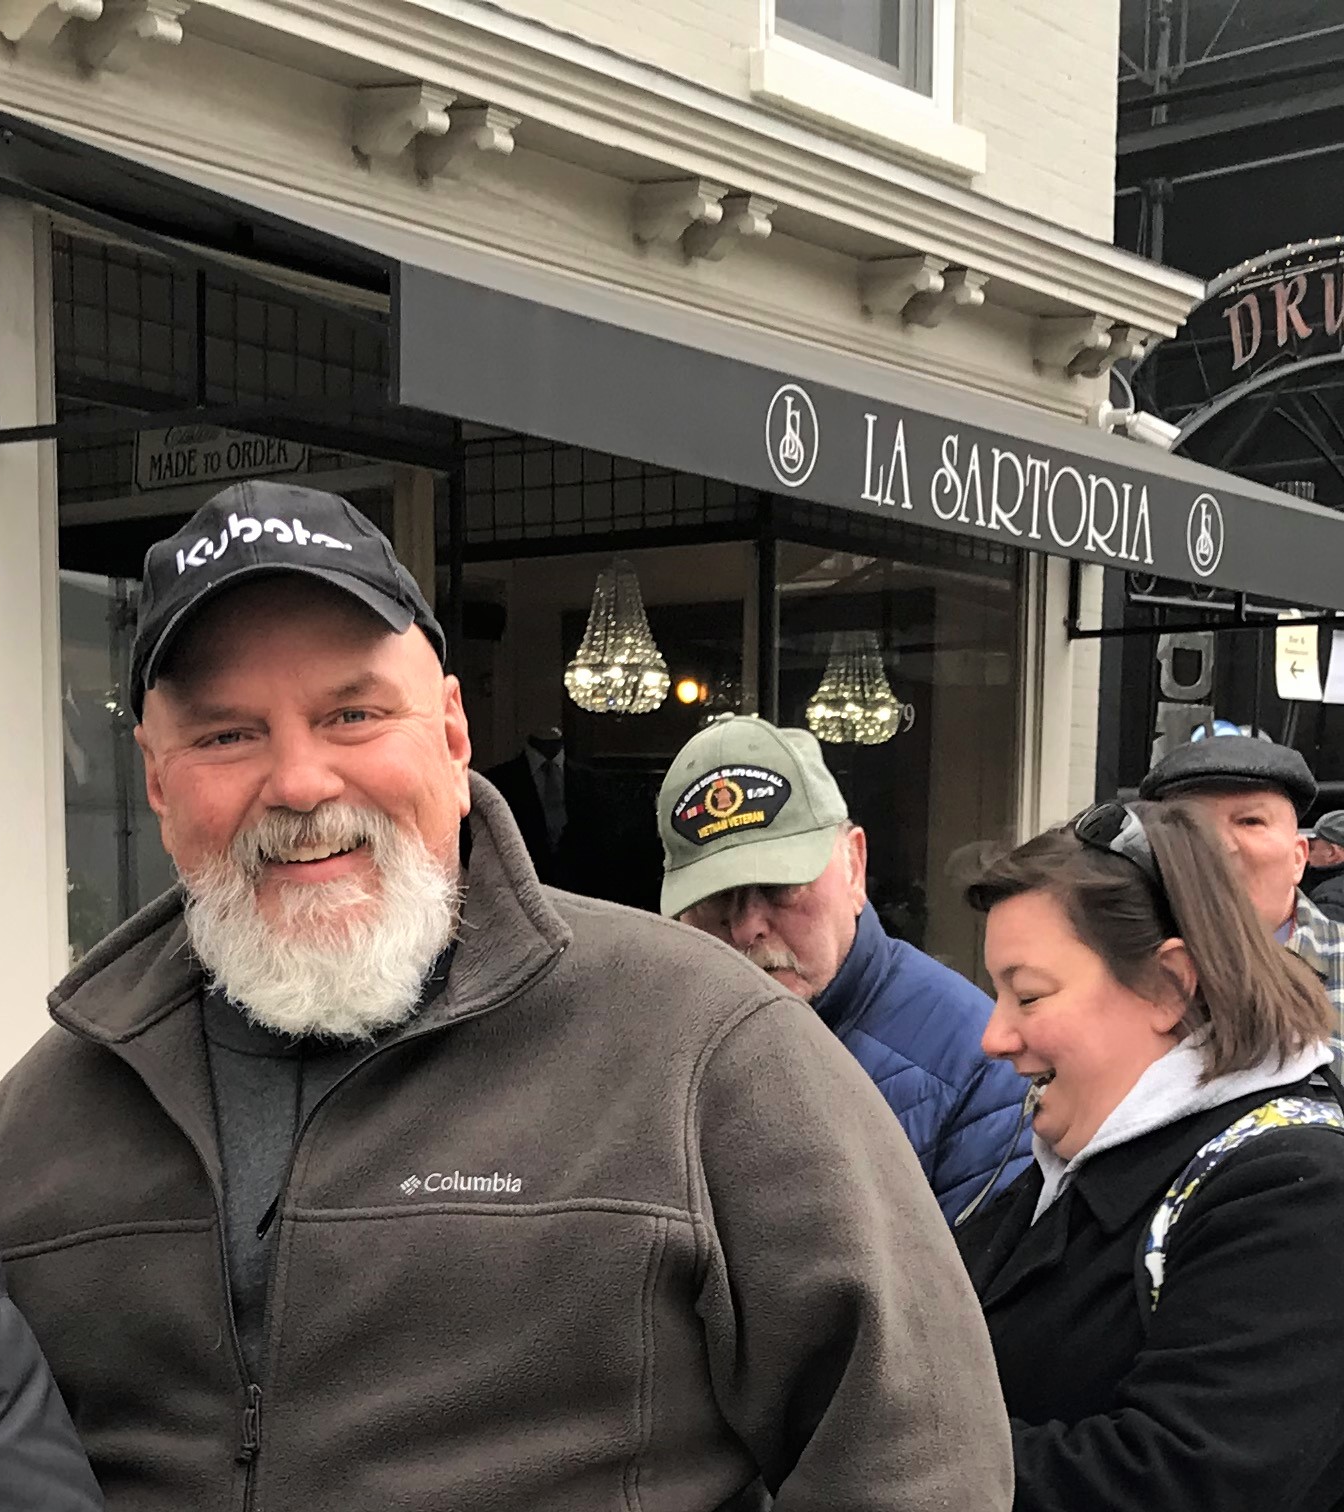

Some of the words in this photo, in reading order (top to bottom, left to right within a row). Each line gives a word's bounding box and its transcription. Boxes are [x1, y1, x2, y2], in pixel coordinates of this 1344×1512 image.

[149, 449, 197, 481] MADE
[227, 438, 288, 470] ORDER
[860, 413, 913, 510] LA
[931, 433, 1155, 565] SARTORIA
[697, 819, 728, 839] VIETNAM
[728, 811, 765, 828] VETERAN
[424, 1171, 522, 1193] Columbia
